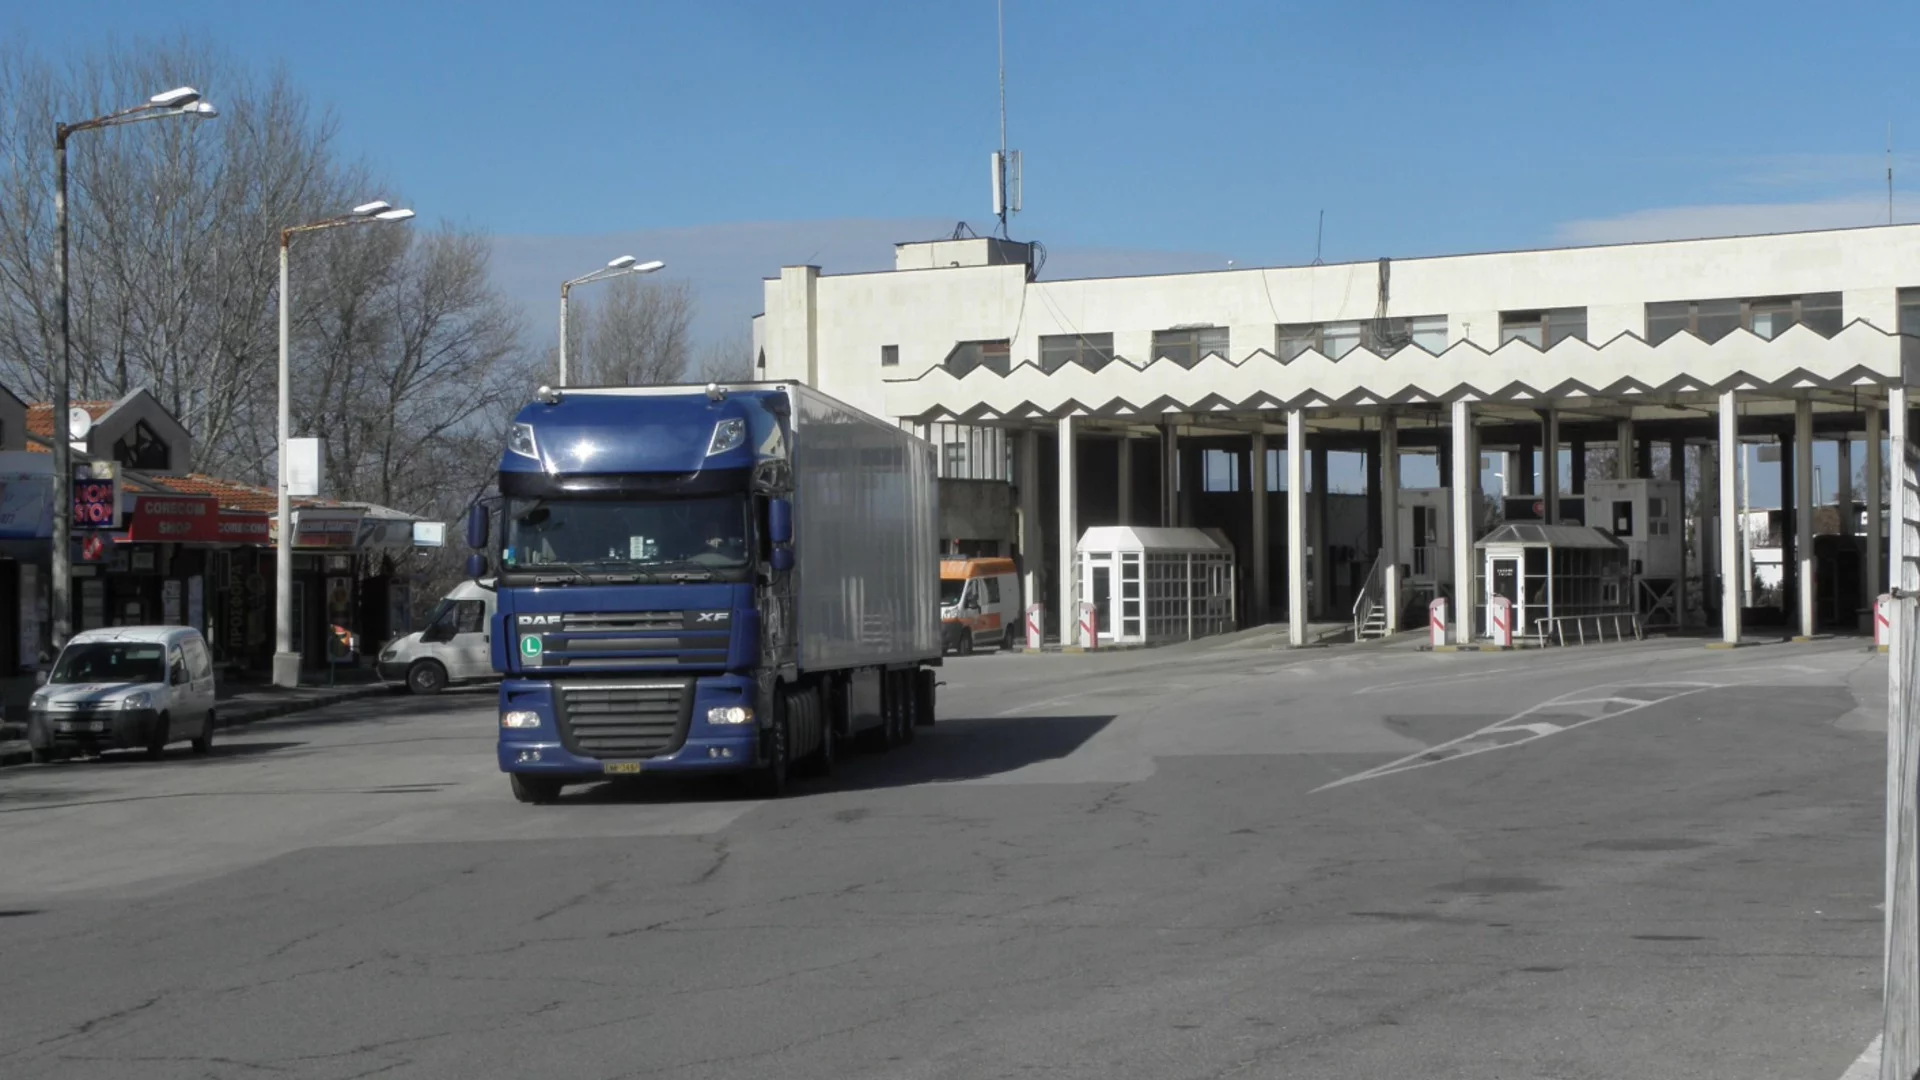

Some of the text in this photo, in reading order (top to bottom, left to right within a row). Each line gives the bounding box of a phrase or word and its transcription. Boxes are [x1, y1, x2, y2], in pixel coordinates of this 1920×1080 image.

[74, 503, 112, 522] STOP
[144, 501, 206, 516] CORECOM
[158, 521, 192, 534] SHOP
[518, 615, 561, 625] DAF
[696, 612, 729, 622] XF
[526, 638, 537, 653] L
